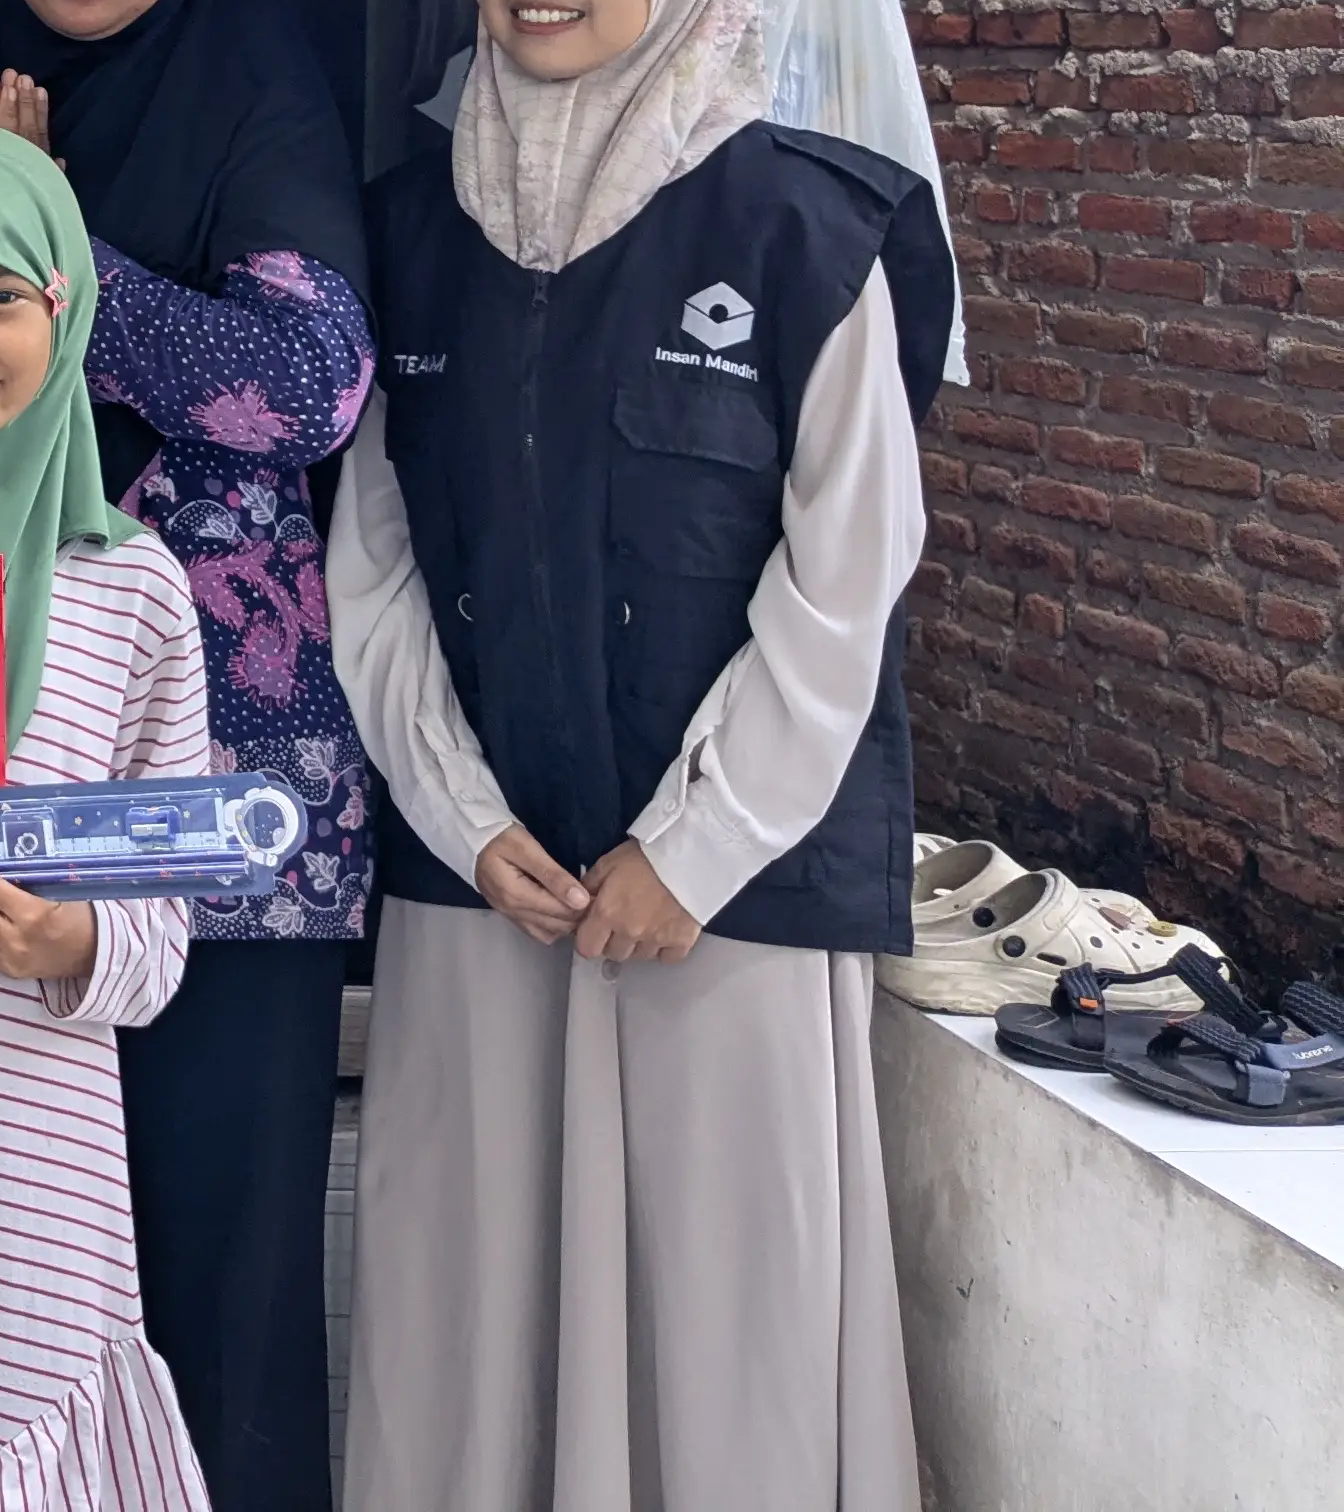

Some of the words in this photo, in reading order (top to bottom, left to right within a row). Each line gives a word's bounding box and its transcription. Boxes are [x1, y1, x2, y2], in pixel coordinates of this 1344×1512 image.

[394, 354, 448, 374] TEAM
[655, 346, 701, 367] Insan
[705, 354, 759, 382] Mandiri
